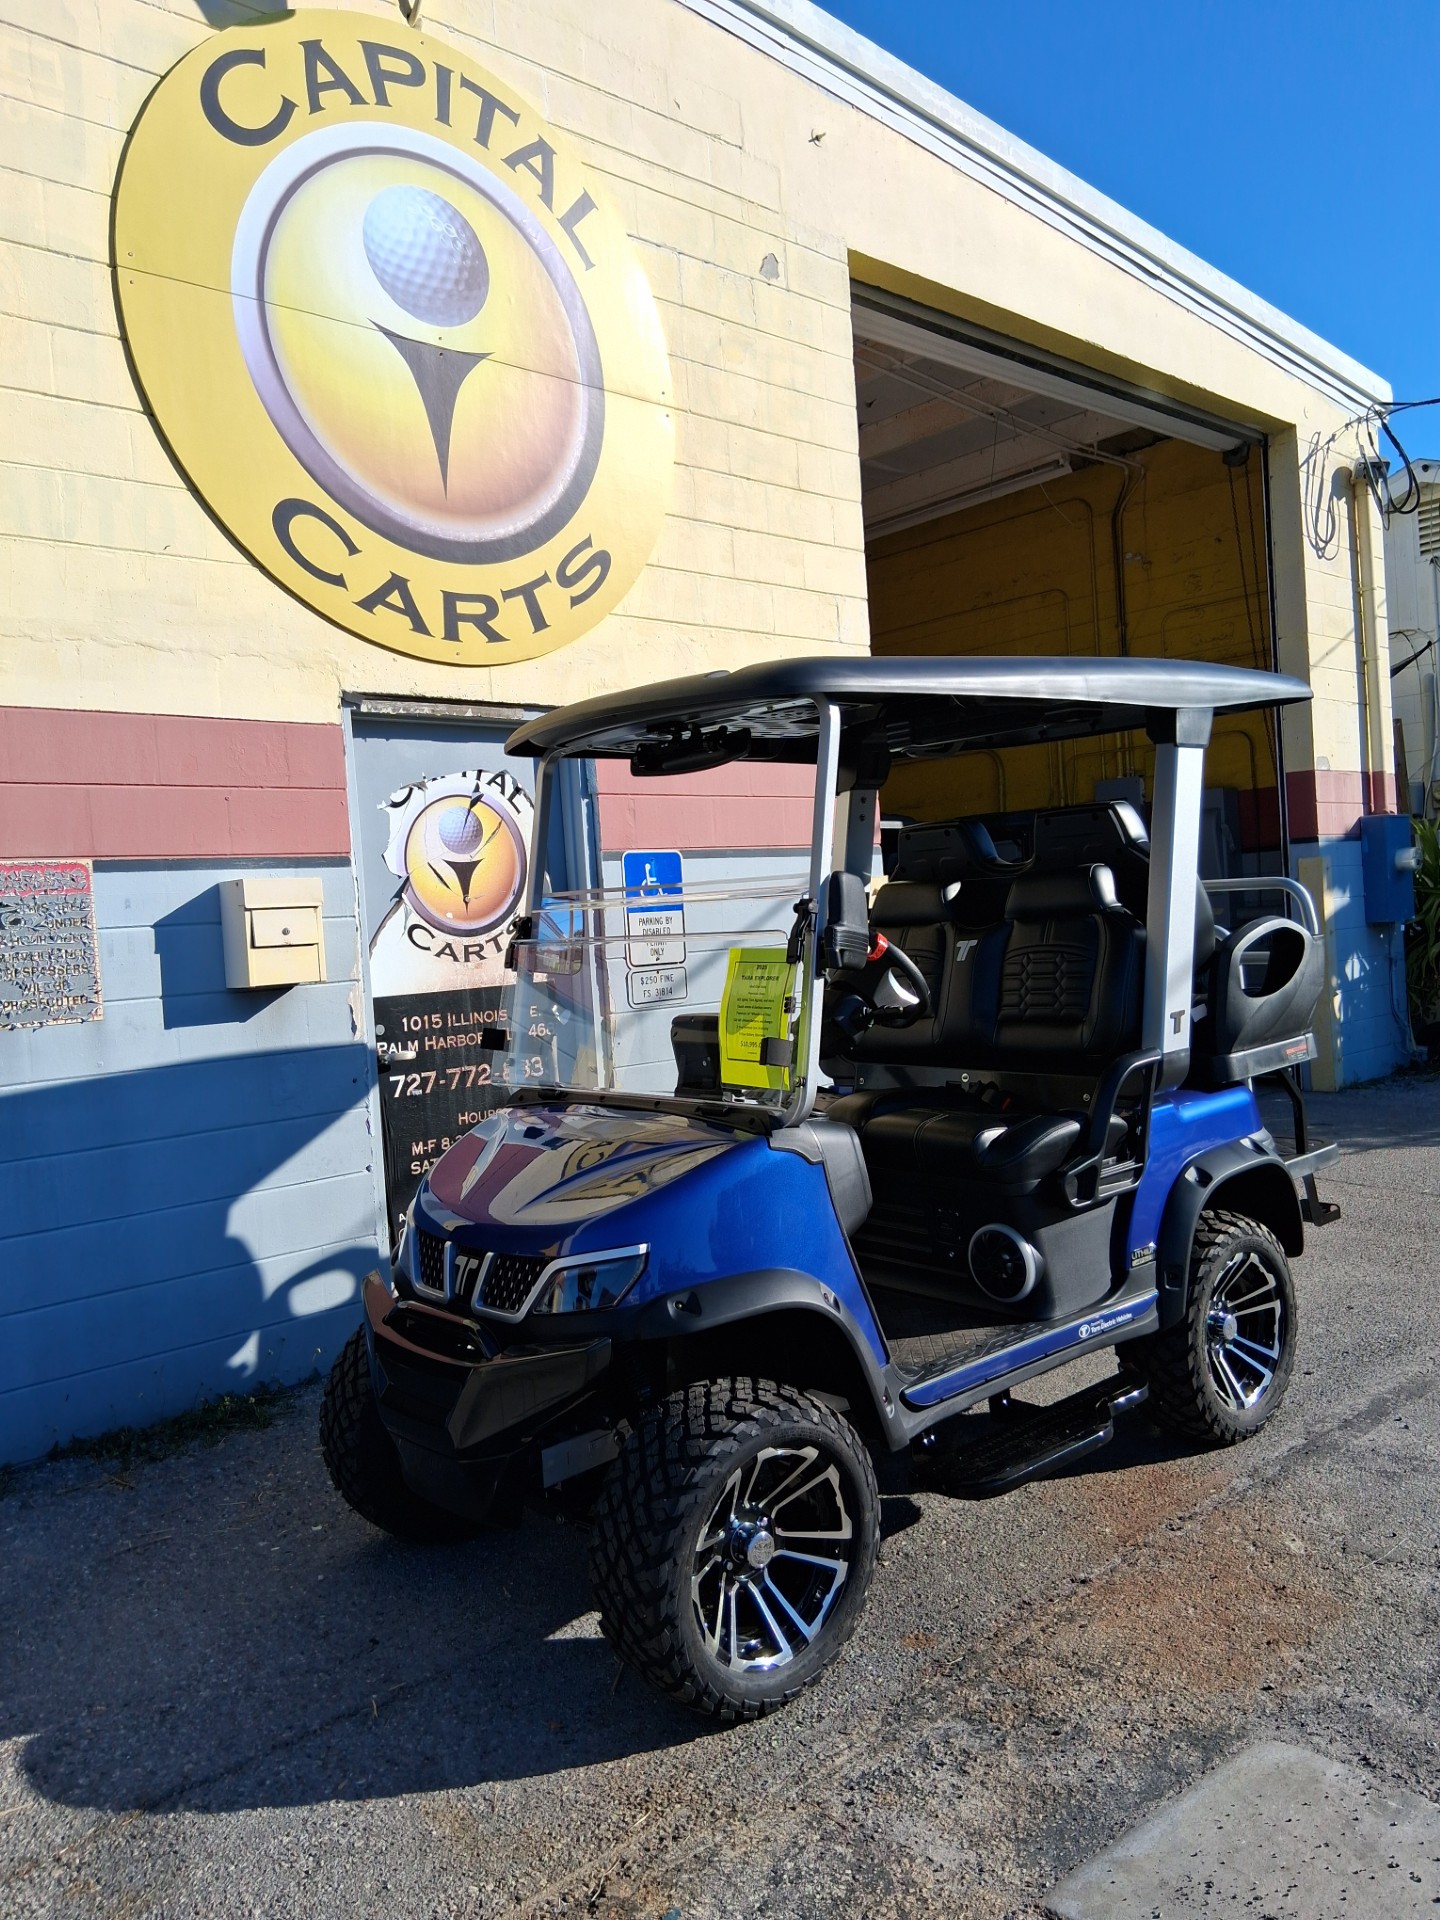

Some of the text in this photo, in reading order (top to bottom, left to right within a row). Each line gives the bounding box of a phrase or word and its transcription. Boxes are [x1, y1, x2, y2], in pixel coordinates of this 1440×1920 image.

[200, 39, 598, 271] CAPITAL
[272, 497, 612, 644] CARTS
[638, 916, 673, 926] PARKING BY
[650, 947, 664, 957] ONLY
[640, 973, 674, 986] $250 FINE
[402, 1013, 442, 1032] 1015
[447, 1009, 508, 1027] ILLINOIS
[376, 1039, 419, 1056] PALM
[458, 1108, 502, 1125] HOUR
[411, 1139, 437, 1156] M-F
[1131, 1246, 1155, 1260] LITHIU
